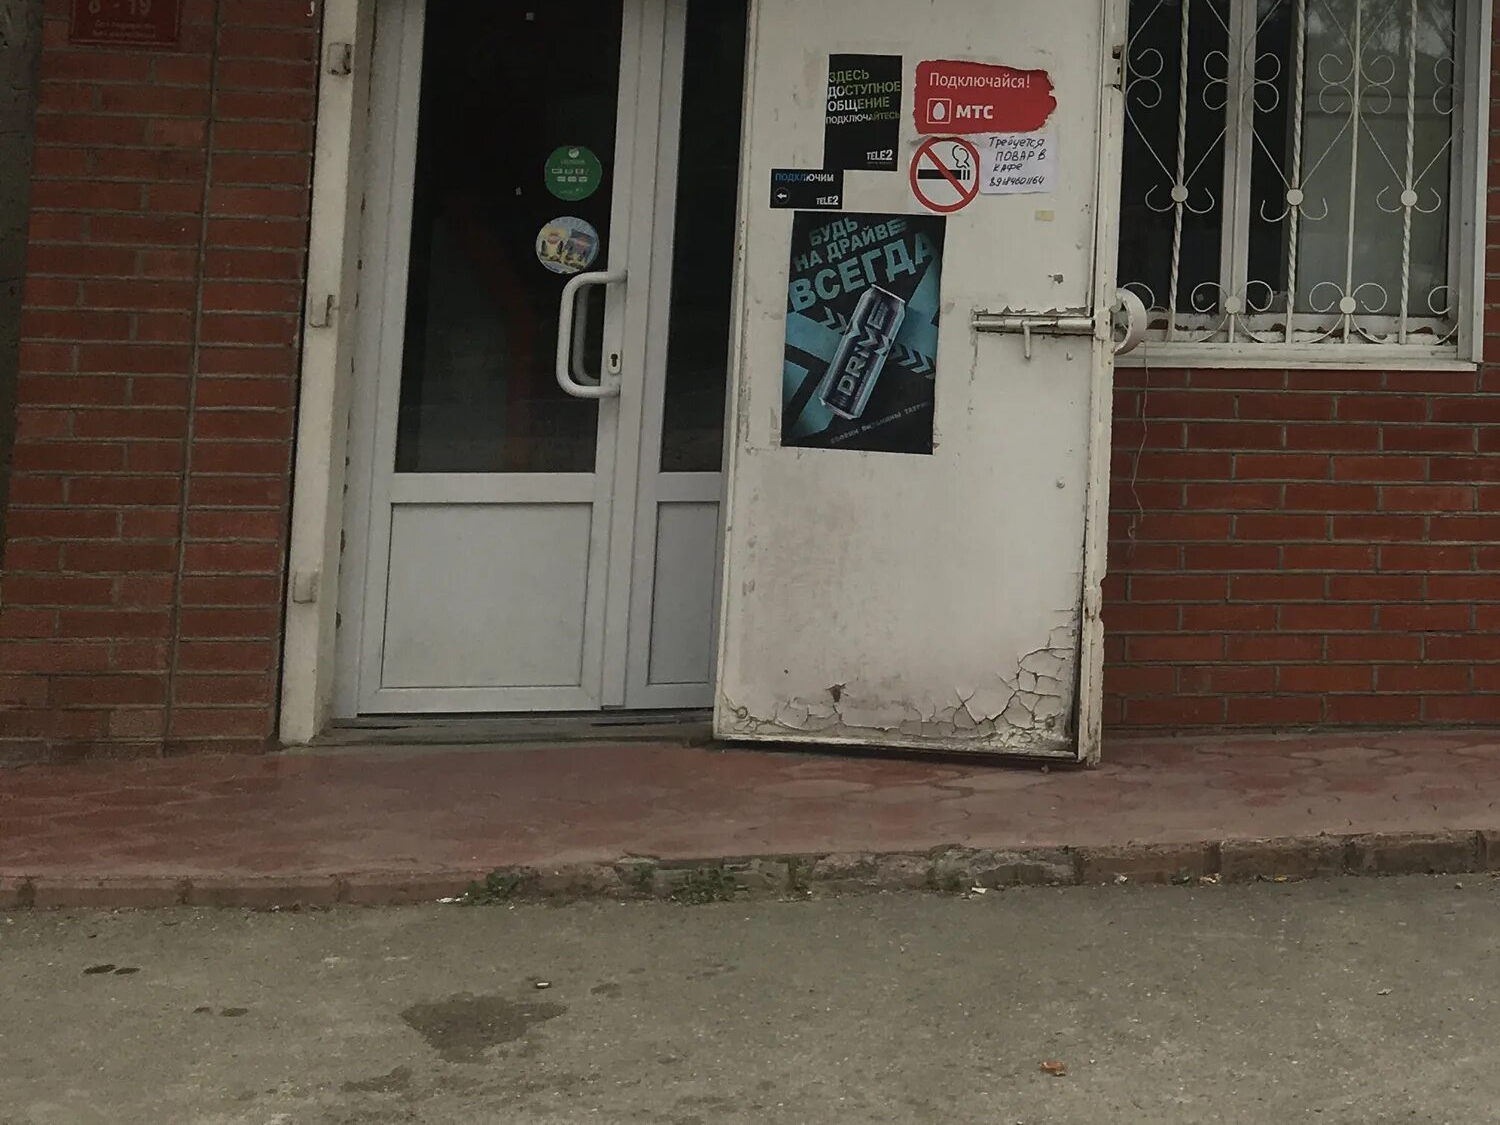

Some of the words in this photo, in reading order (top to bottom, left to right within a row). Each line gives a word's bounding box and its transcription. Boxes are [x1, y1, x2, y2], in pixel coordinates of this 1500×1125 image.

[829, 69, 870, 83] ЗДЕСЬ
[929, 72, 1030, 89] Подключайся!
[827, 81, 901, 99] ДОСТУПНОЕ
[827, 96, 890, 112] ОБЩЕНИЕ
[826, 111, 900, 125] ПОДКЛЮЧАЙТЕСЬ
[955, 104, 994, 120] МТС
[989, 135, 1045, 149] Требуется
[866, 149, 893, 161] TELE2
[995, 150, 1035, 162] ПОВАР
[775, 172, 834, 182] ПОДКЛЮЧИМ
[816, 195, 839, 205] TELE2
[808, 217, 858, 247] БУДЬ
[794, 249, 823, 272] НА
[825, 219, 907, 263] ДРАЙВЕ
[789, 232, 933, 312] ВСЕГДА
